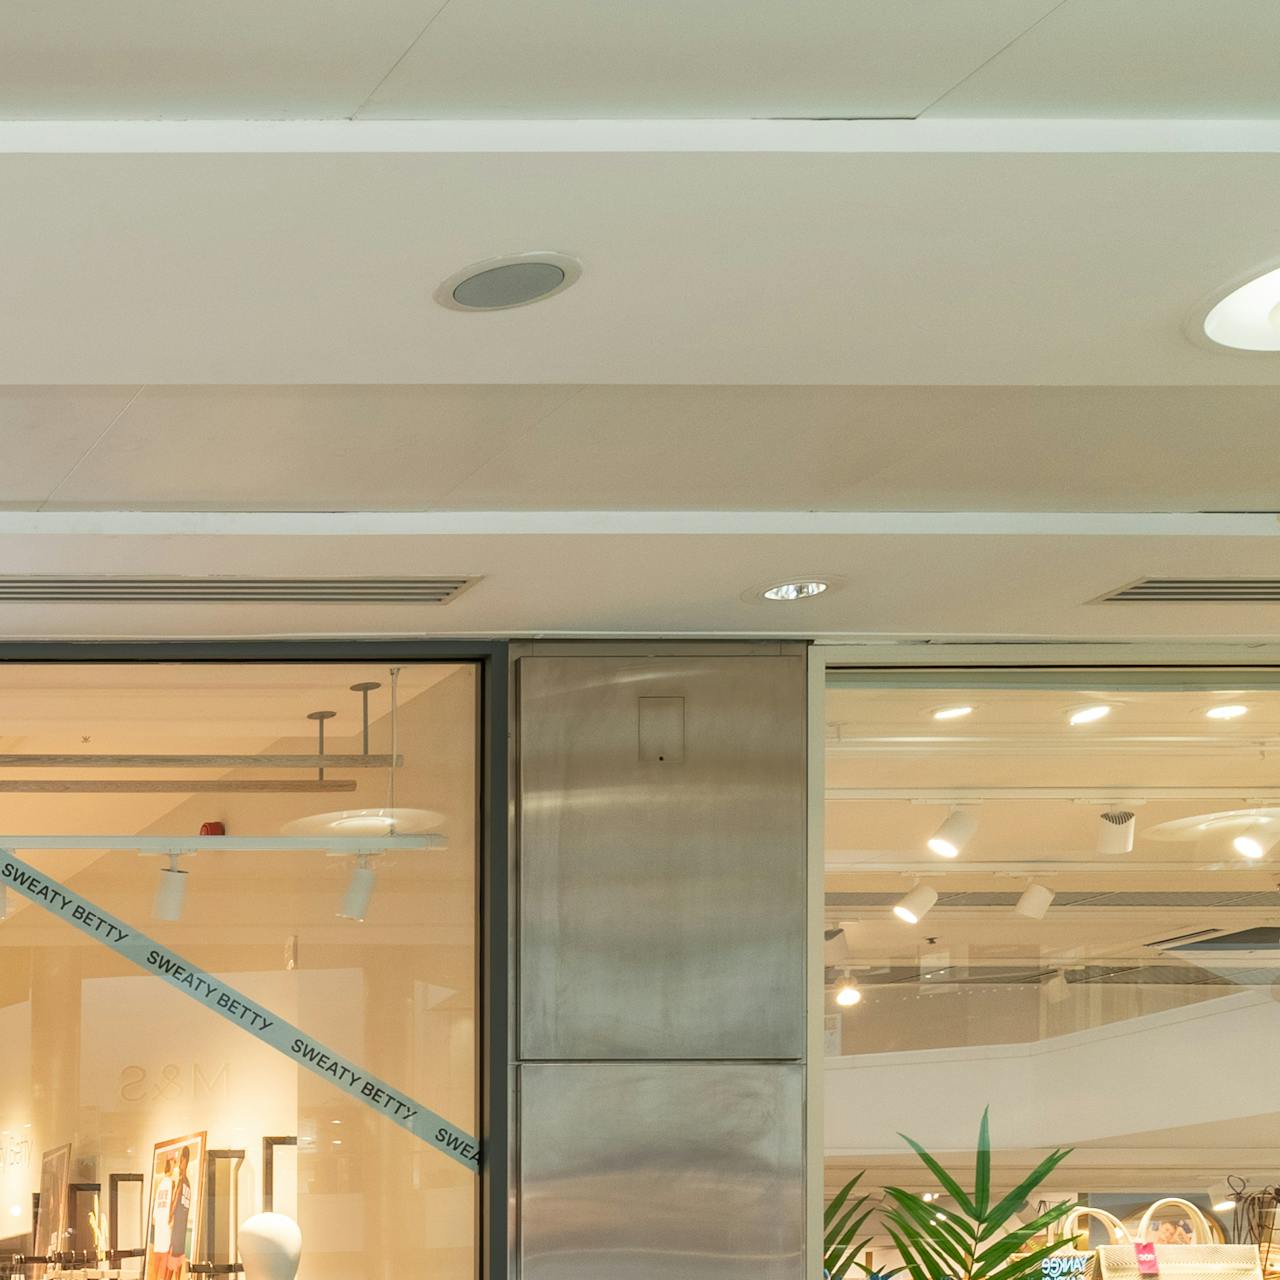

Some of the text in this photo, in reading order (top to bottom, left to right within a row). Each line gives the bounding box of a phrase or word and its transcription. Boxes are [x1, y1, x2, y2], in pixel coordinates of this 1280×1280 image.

[1, 862, 73, 910] SWEATY
[71, 904, 129, 943] BETTY
[146, 950, 218, 998] SWEATY
[216, 992, 274, 1031] BETTY
[290, 1038, 362, 1087] SWEATY
[360, 1081, 418, 1120] BETTY
[435, 1128, 481, 1166] SWEA
